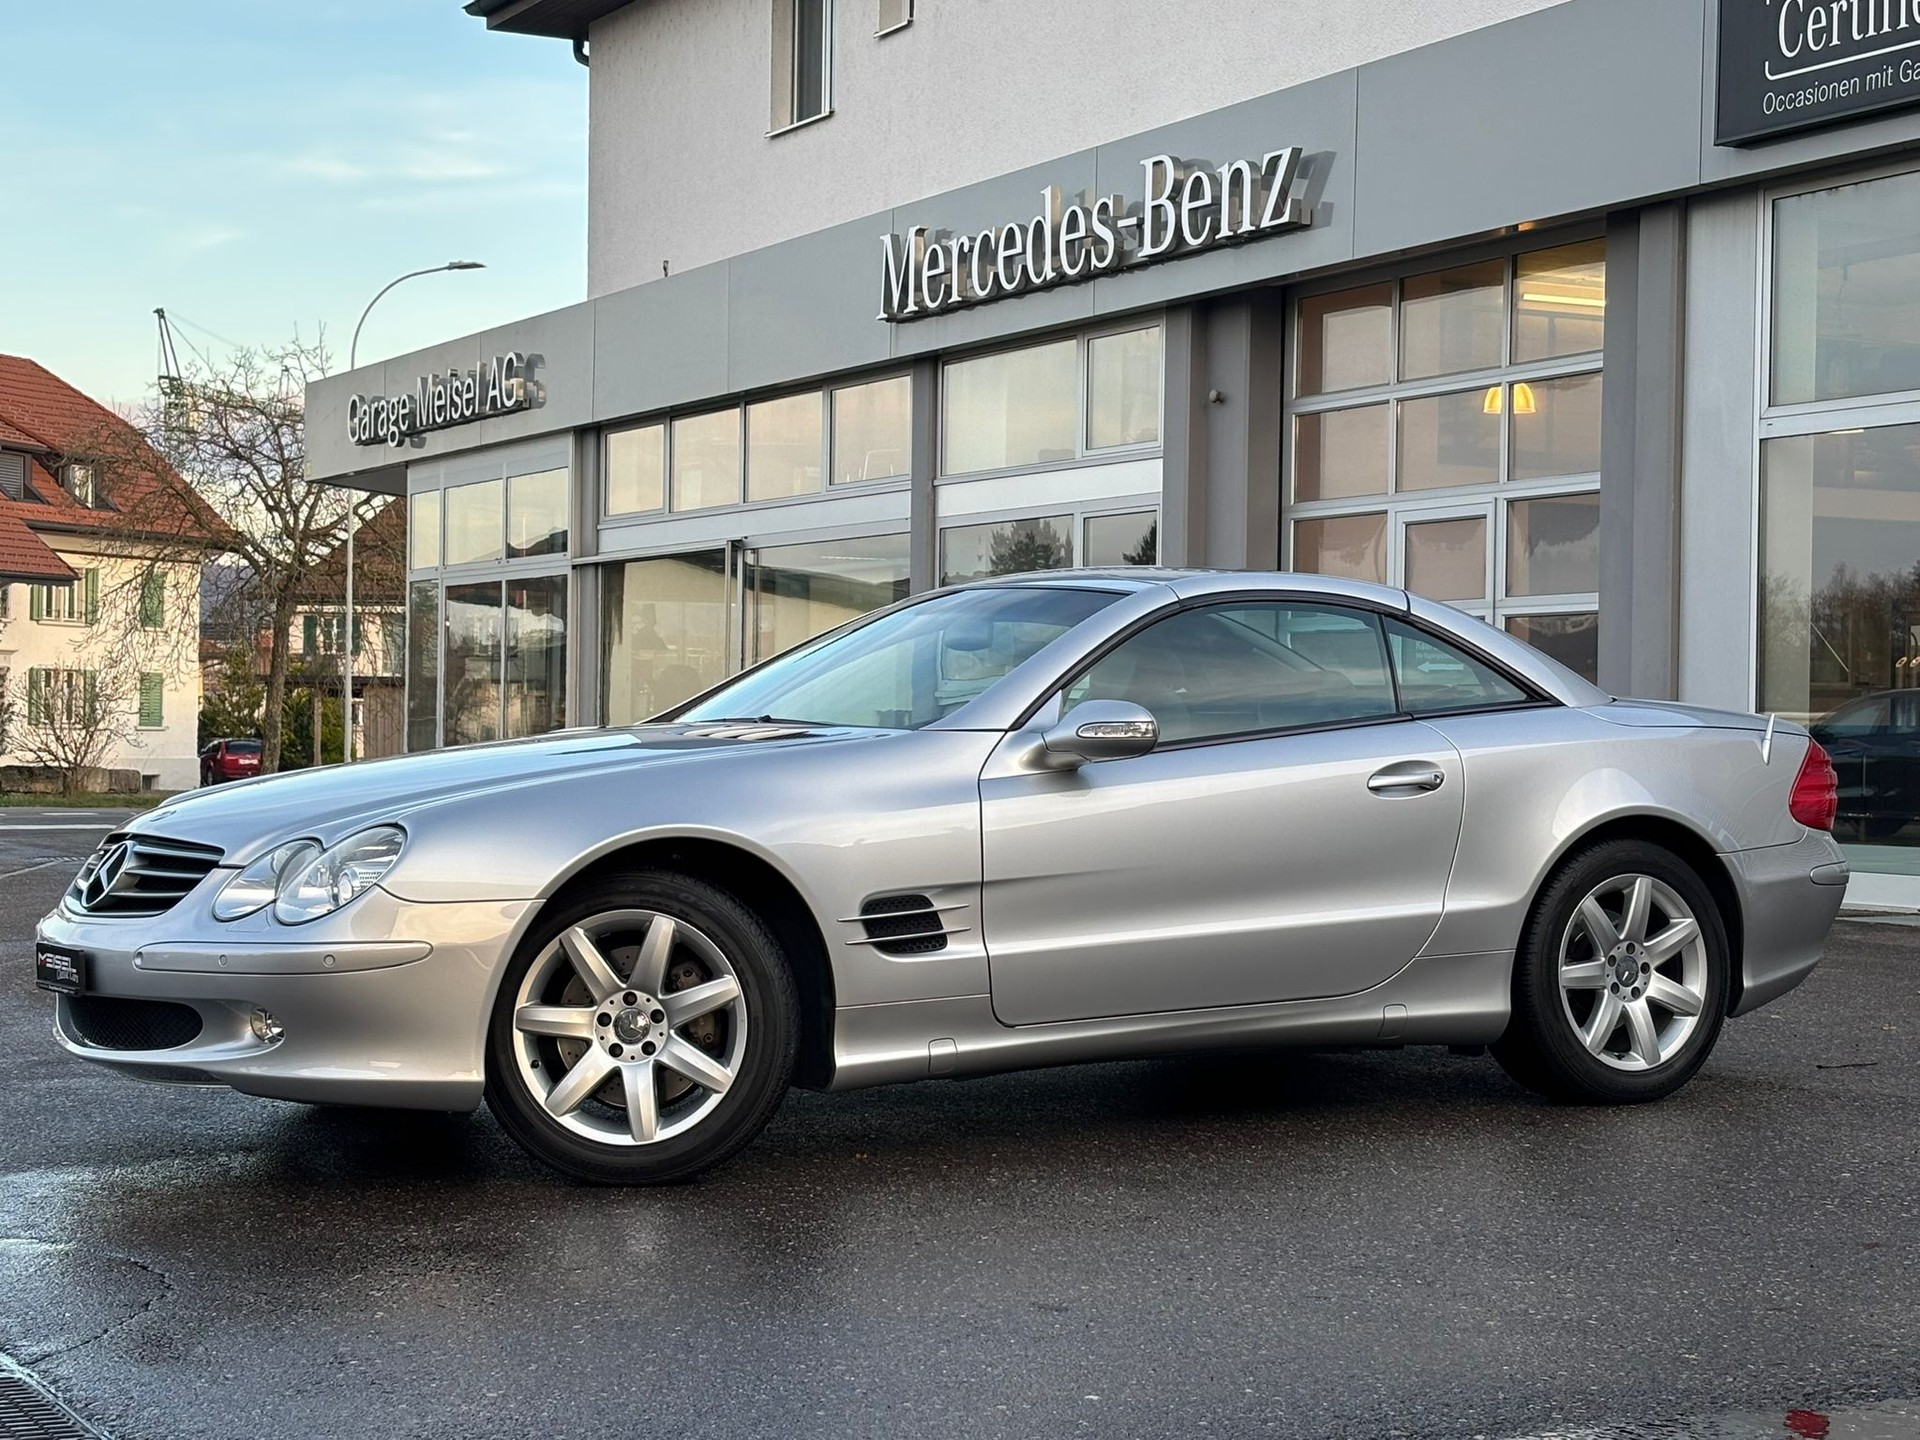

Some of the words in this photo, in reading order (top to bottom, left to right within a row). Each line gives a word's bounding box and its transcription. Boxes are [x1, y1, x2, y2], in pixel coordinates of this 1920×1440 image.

[1763, 77, 1860, 115] Occasionen
[1866, 64, 1893, 91] mit
[876, 147, 1306, 321] Mercedes-Benz
[347, 393, 410, 448] Garage
[416, 360, 481, 428] Meisel
[485, 351, 520, 412] AG
